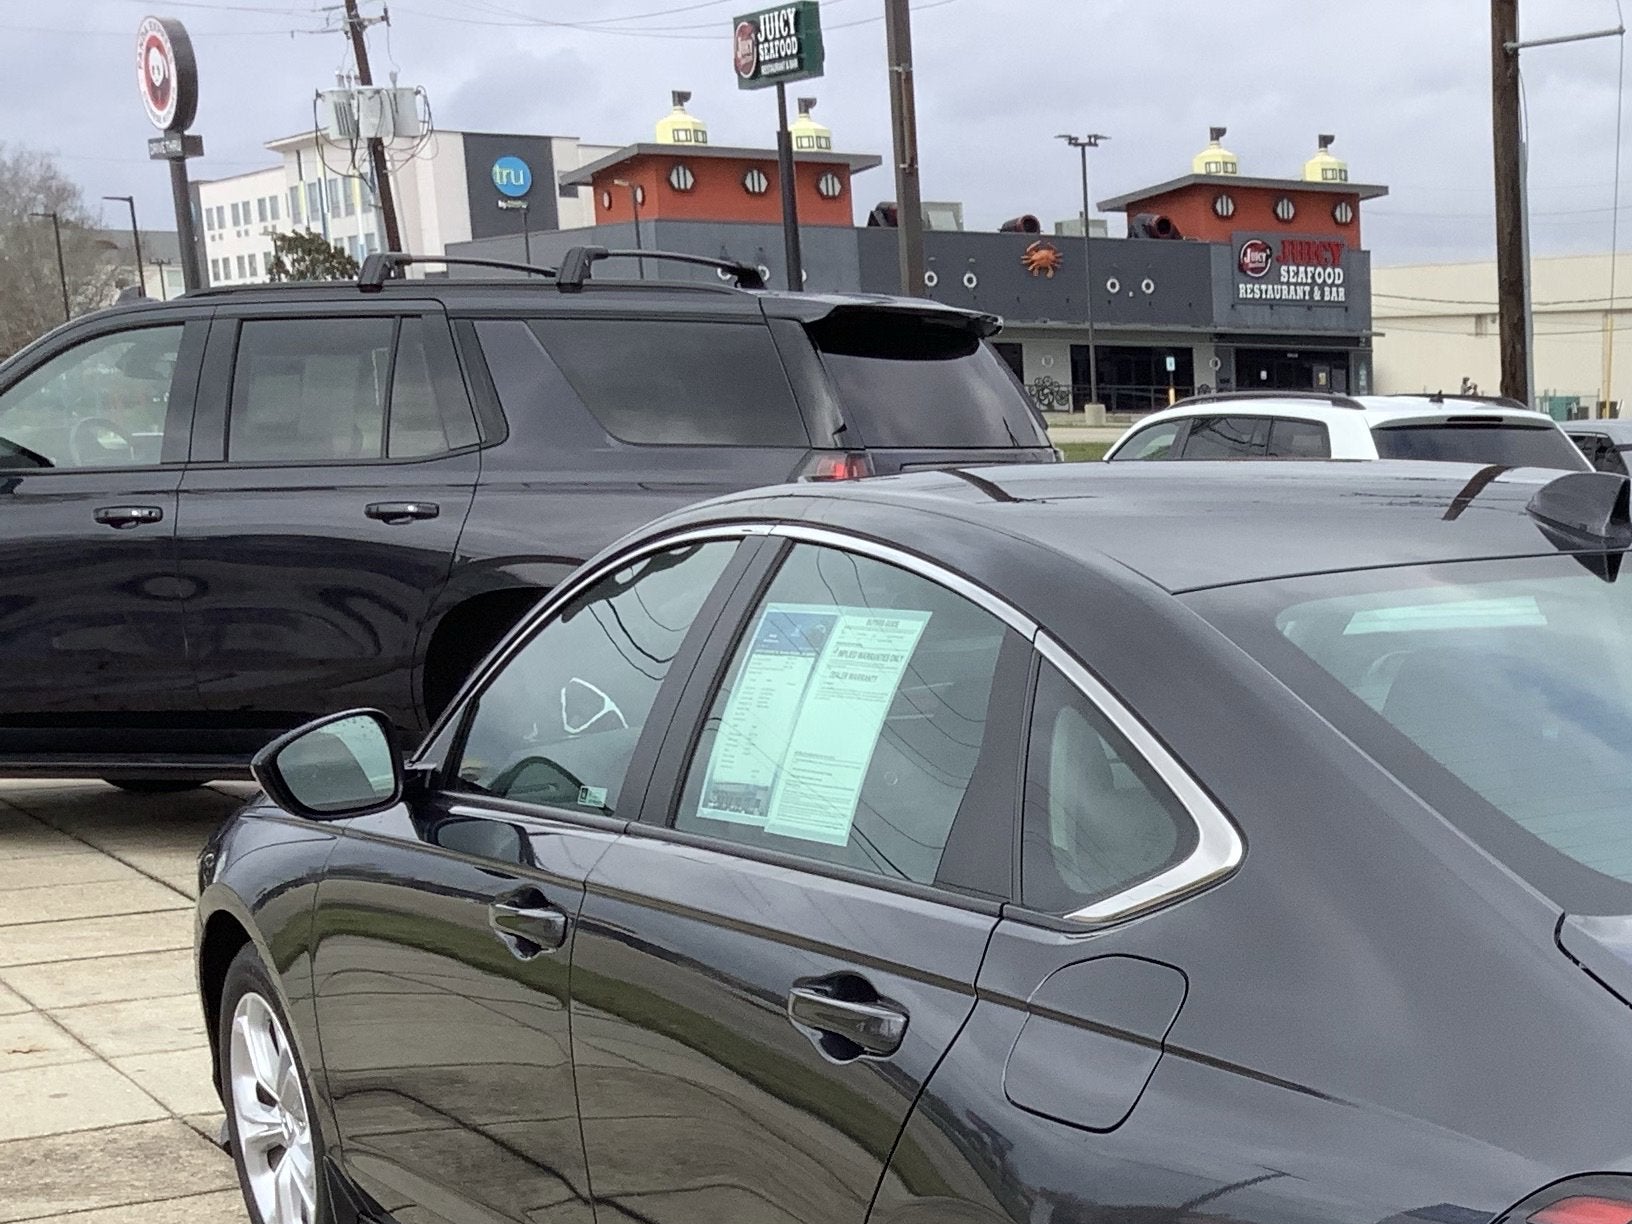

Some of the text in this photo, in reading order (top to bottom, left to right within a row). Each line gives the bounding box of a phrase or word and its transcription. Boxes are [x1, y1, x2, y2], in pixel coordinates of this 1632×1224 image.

[757, 7, 796, 42] JUICY
[758, 36, 798, 61] SEAFOOD
[494, 163, 524, 185] tru
[1276, 240, 1345, 266] JUICY
[1280, 265, 1344, 285] SEAFOOD
[1239, 283, 1346, 302] RESTAURANT & BAR
